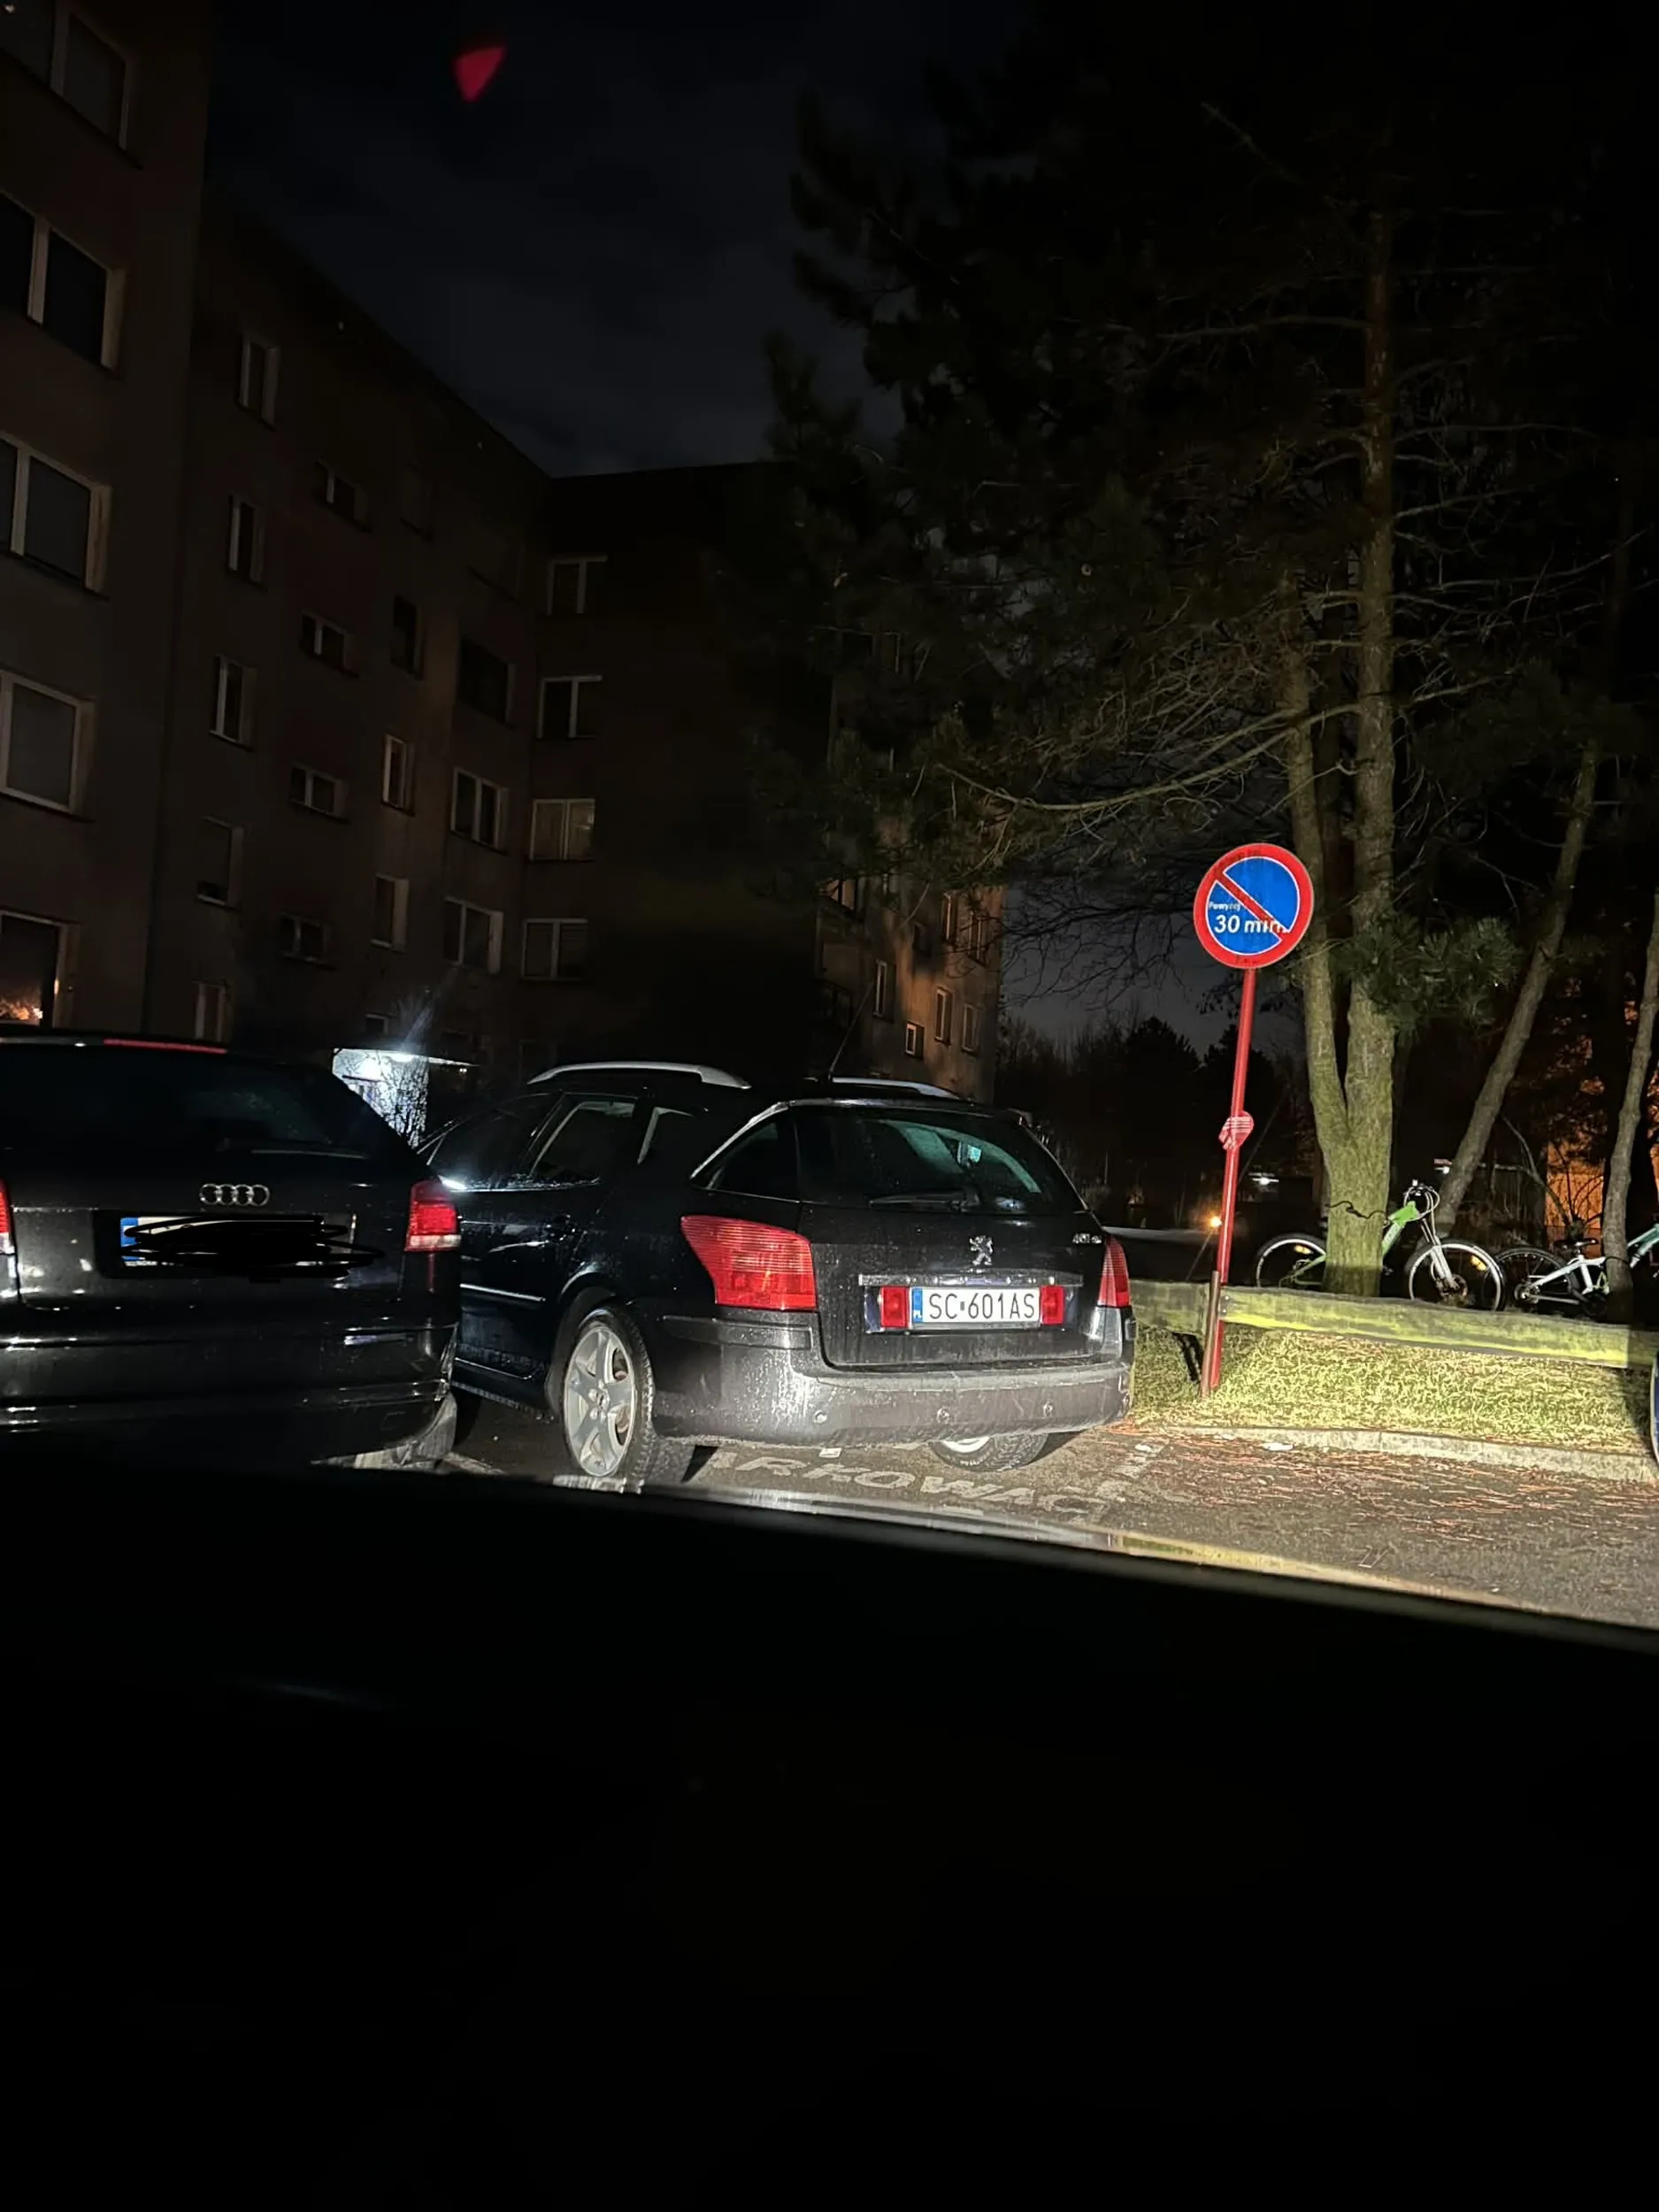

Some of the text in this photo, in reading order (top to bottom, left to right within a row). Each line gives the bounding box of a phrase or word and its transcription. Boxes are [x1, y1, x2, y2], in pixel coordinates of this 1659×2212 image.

[1214, 915, 1240, 933] 30
[929, 1293, 1034, 1319] SC 601AS
